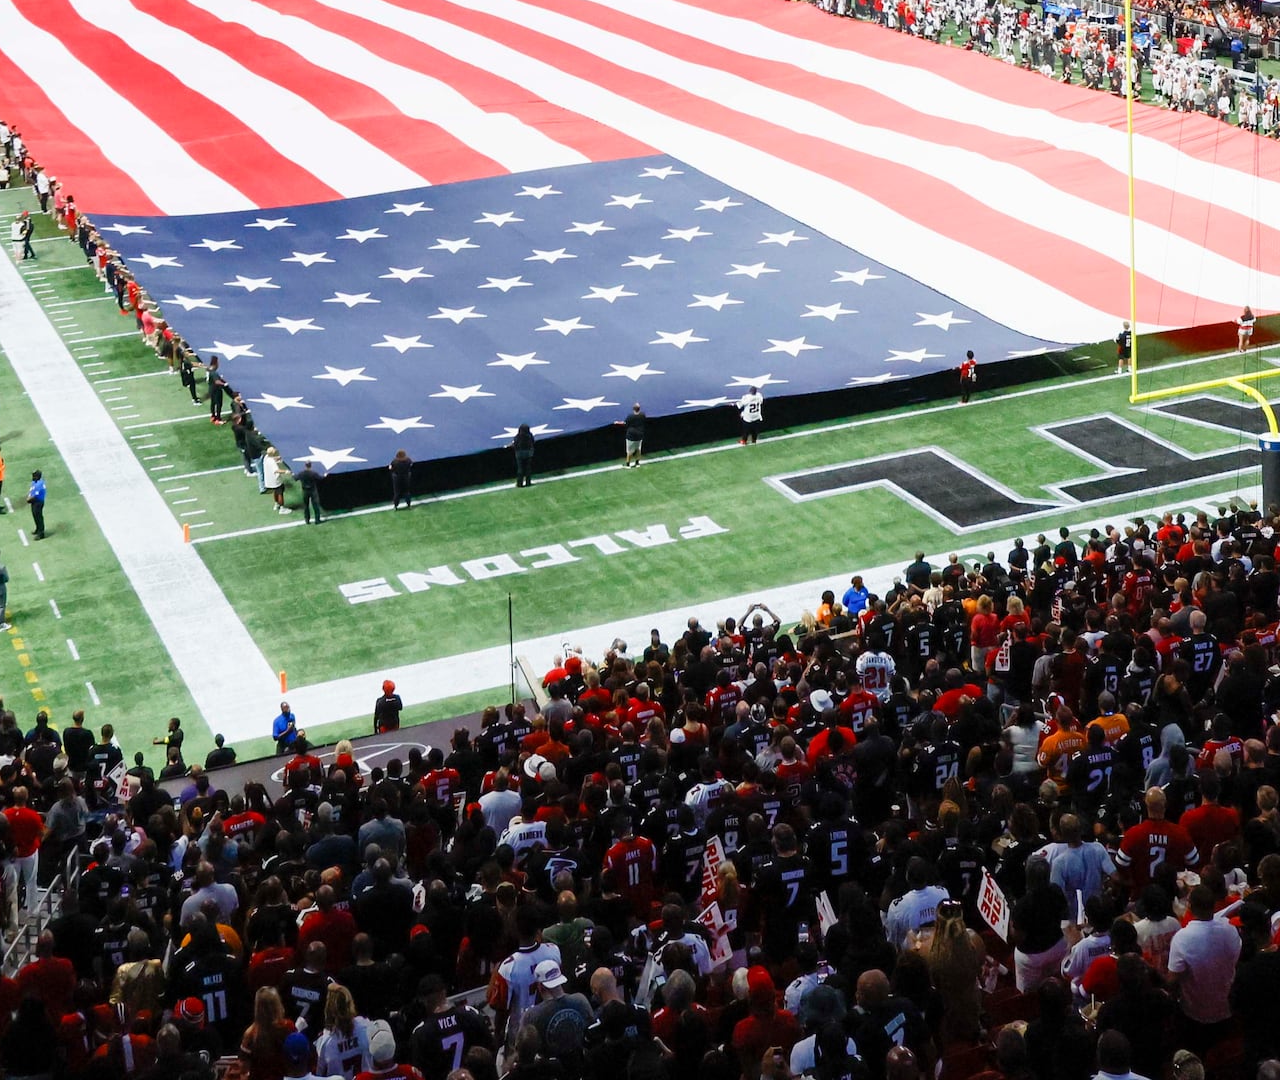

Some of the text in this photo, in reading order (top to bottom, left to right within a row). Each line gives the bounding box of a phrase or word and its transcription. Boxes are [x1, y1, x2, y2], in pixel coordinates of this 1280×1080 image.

[1246, 539, 1253, 553] 7
[338, 515, 731, 605] FALCONS
[884, 629, 893, 647] 7
[920, 638, 930, 656] 5
[1194, 652, 1213, 672] 27
[864, 667, 887, 689] 21
[1104, 675, 1117, 692] 13
[1088, 752, 1112, 764] SANDERS
[1142, 746, 1154, 769] 8
[1088, 766, 1112, 791] 21
[765, 809, 777, 829] 7
[1149, 834, 1168, 845] RYAN
[831, 841, 848, 875] 5
[628, 863, 639, 886] 11
[685, 859, 700, 883] 7
[786, 881, 800, 908] 7
[203, 990, 228, 1022] 11
[438, 1014, 457, 1029] VICK
[440, 1032, 465, 1071] 7
